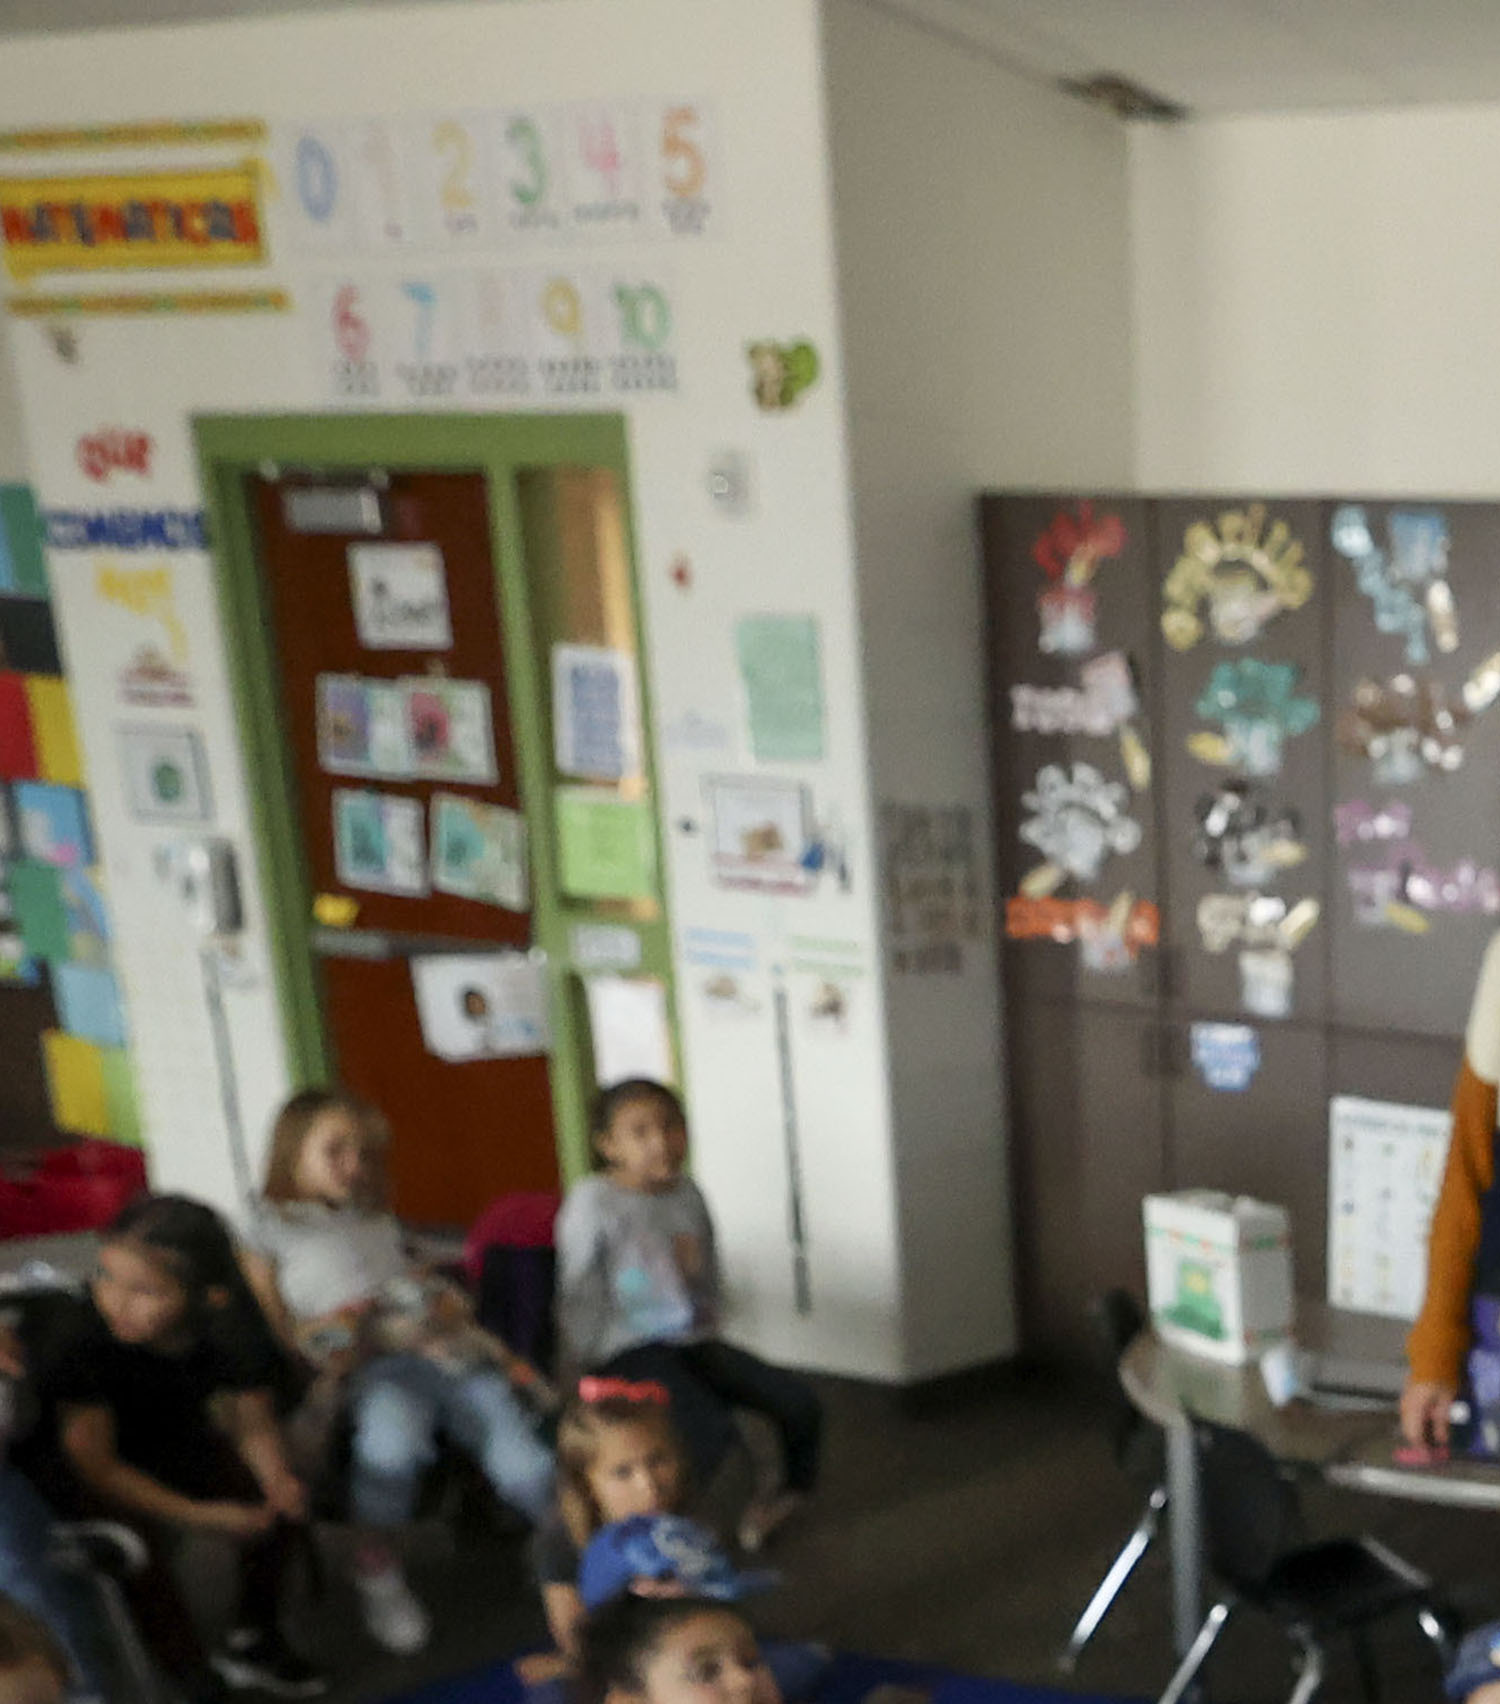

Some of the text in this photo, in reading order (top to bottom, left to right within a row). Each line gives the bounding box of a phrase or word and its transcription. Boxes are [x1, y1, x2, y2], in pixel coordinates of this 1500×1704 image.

[295, 134, 340, 225] 0
[430, 117, 477, 211] 2
[504, 114, 552, 207] 3
[577, 118, 622, 200] 4
[660, 104, 709, 200] 5
[331, 281, 371, 364] 6
[537, 273, 586, 347] 9
[609, 279, 674, 353] 10
